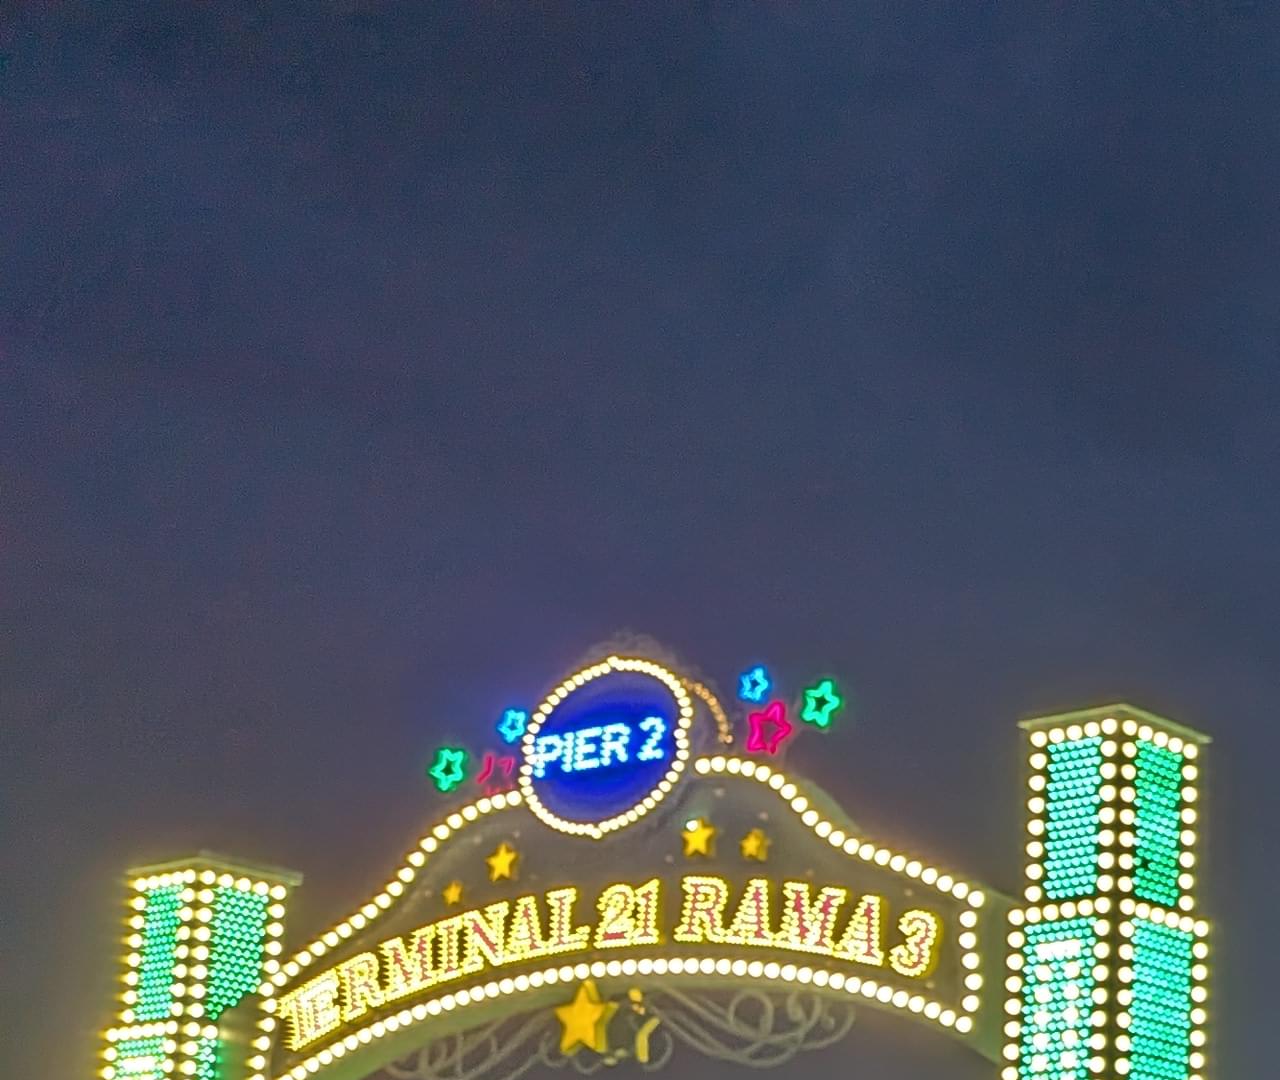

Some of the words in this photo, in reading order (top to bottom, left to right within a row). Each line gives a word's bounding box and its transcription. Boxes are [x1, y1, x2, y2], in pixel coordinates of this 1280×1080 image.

[533, 722, 631, 778] PIER
[637, 716, 666, 761] 2
[276, 887, 591, 1051] TERMINAL
[594, 878, 660, 949] 21
[674, 876, 884, 966] RAMA
[889, 910, 937, 976] 3
